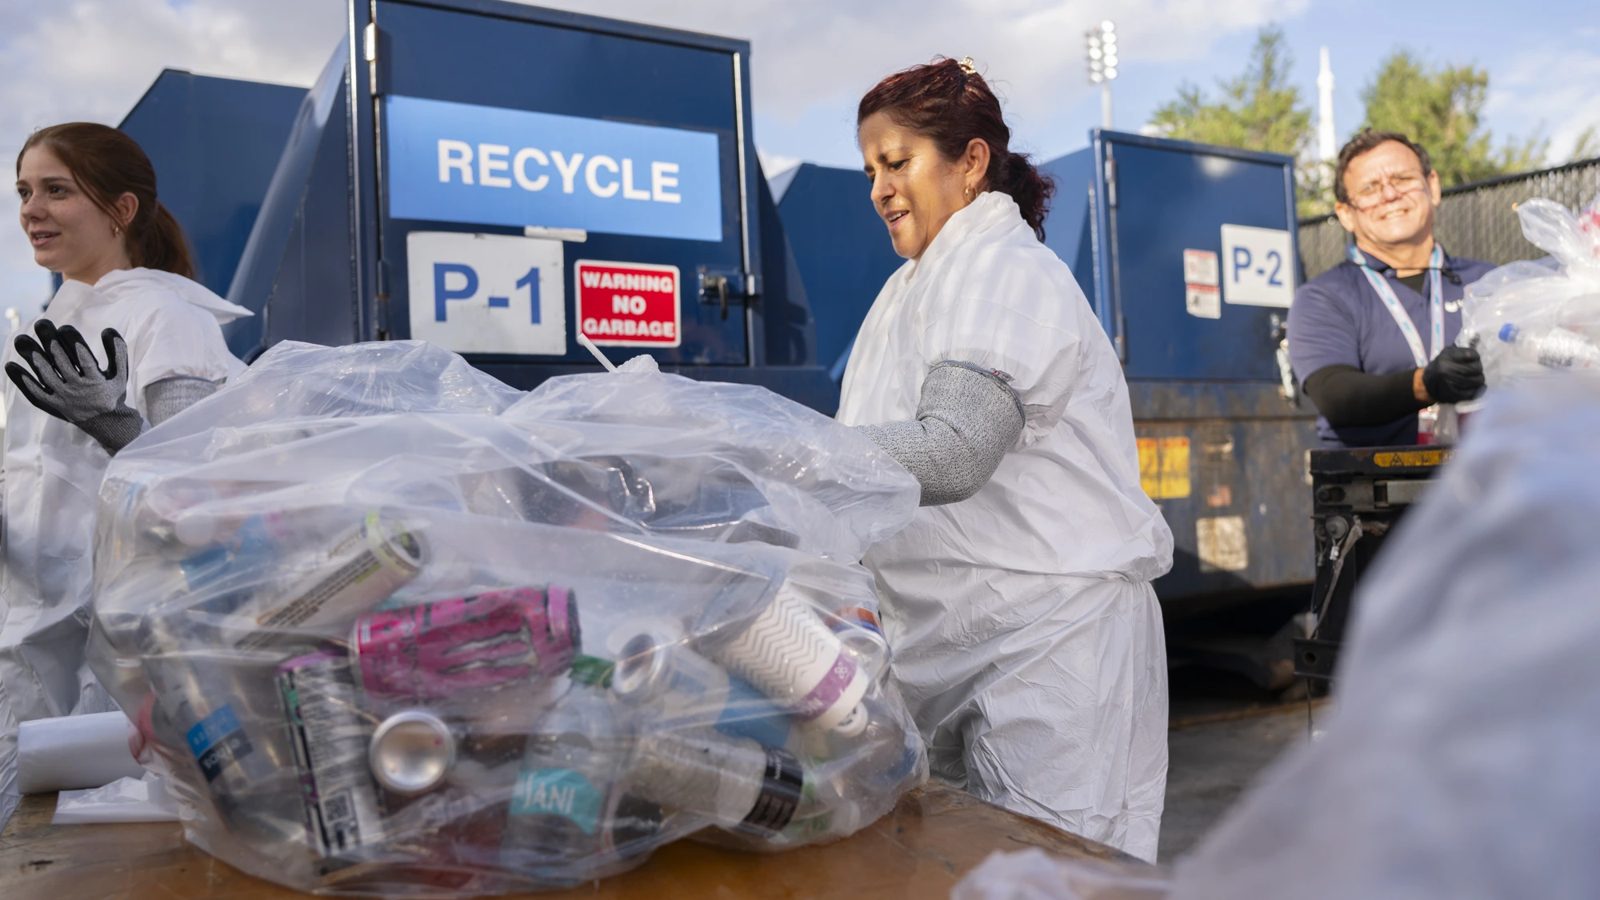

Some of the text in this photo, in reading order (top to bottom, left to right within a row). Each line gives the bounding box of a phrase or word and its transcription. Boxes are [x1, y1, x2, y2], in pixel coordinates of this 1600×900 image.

[437, 139, 682, 204] RECYCLE
[582, 271, 674, 293] WARNING
[1232, 246, 1283, 287] P-2
[433, 262, 542, 325] P-1
[612, 295, 647, 315] NO
[583, 317, 675, 338] GARBAGE
